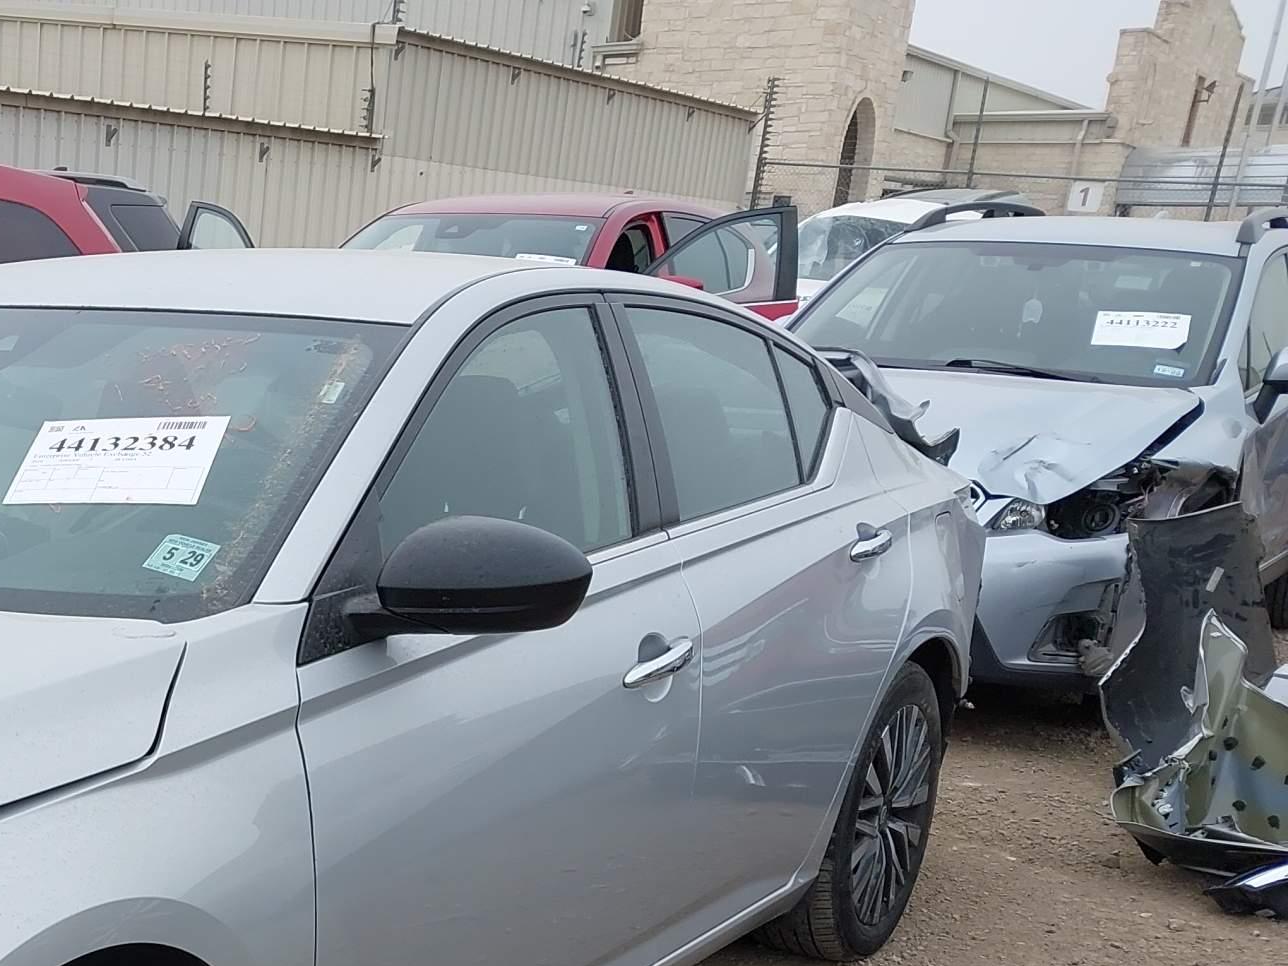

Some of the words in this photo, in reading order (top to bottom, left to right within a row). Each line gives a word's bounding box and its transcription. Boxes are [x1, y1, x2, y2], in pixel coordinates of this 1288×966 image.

[1079, 186, 1090, 207] 1
[49, 435, 196, 453] 44132384
[162, 546, 180, 561] 5
[179, 550, 205, 567] 29
